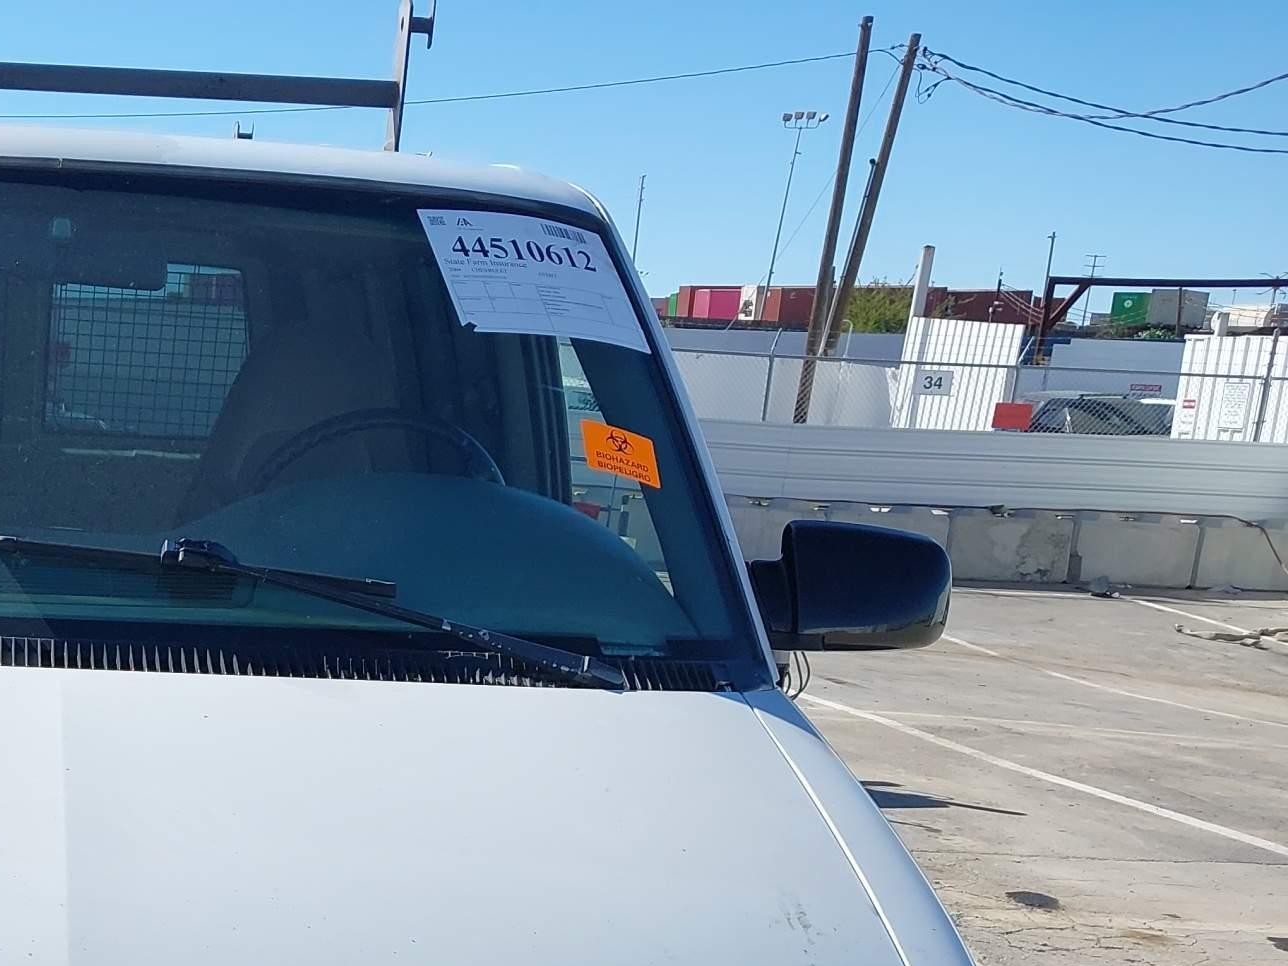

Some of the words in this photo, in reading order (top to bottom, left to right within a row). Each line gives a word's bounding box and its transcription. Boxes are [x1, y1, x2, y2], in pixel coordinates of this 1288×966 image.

[452, 235, 597, 272] 44510612
[923, 375, 943, 390] 34
[596, 450, 649, 473] BIOHAZARD
[597, 460, 651, 482] BIOPELIGRO
